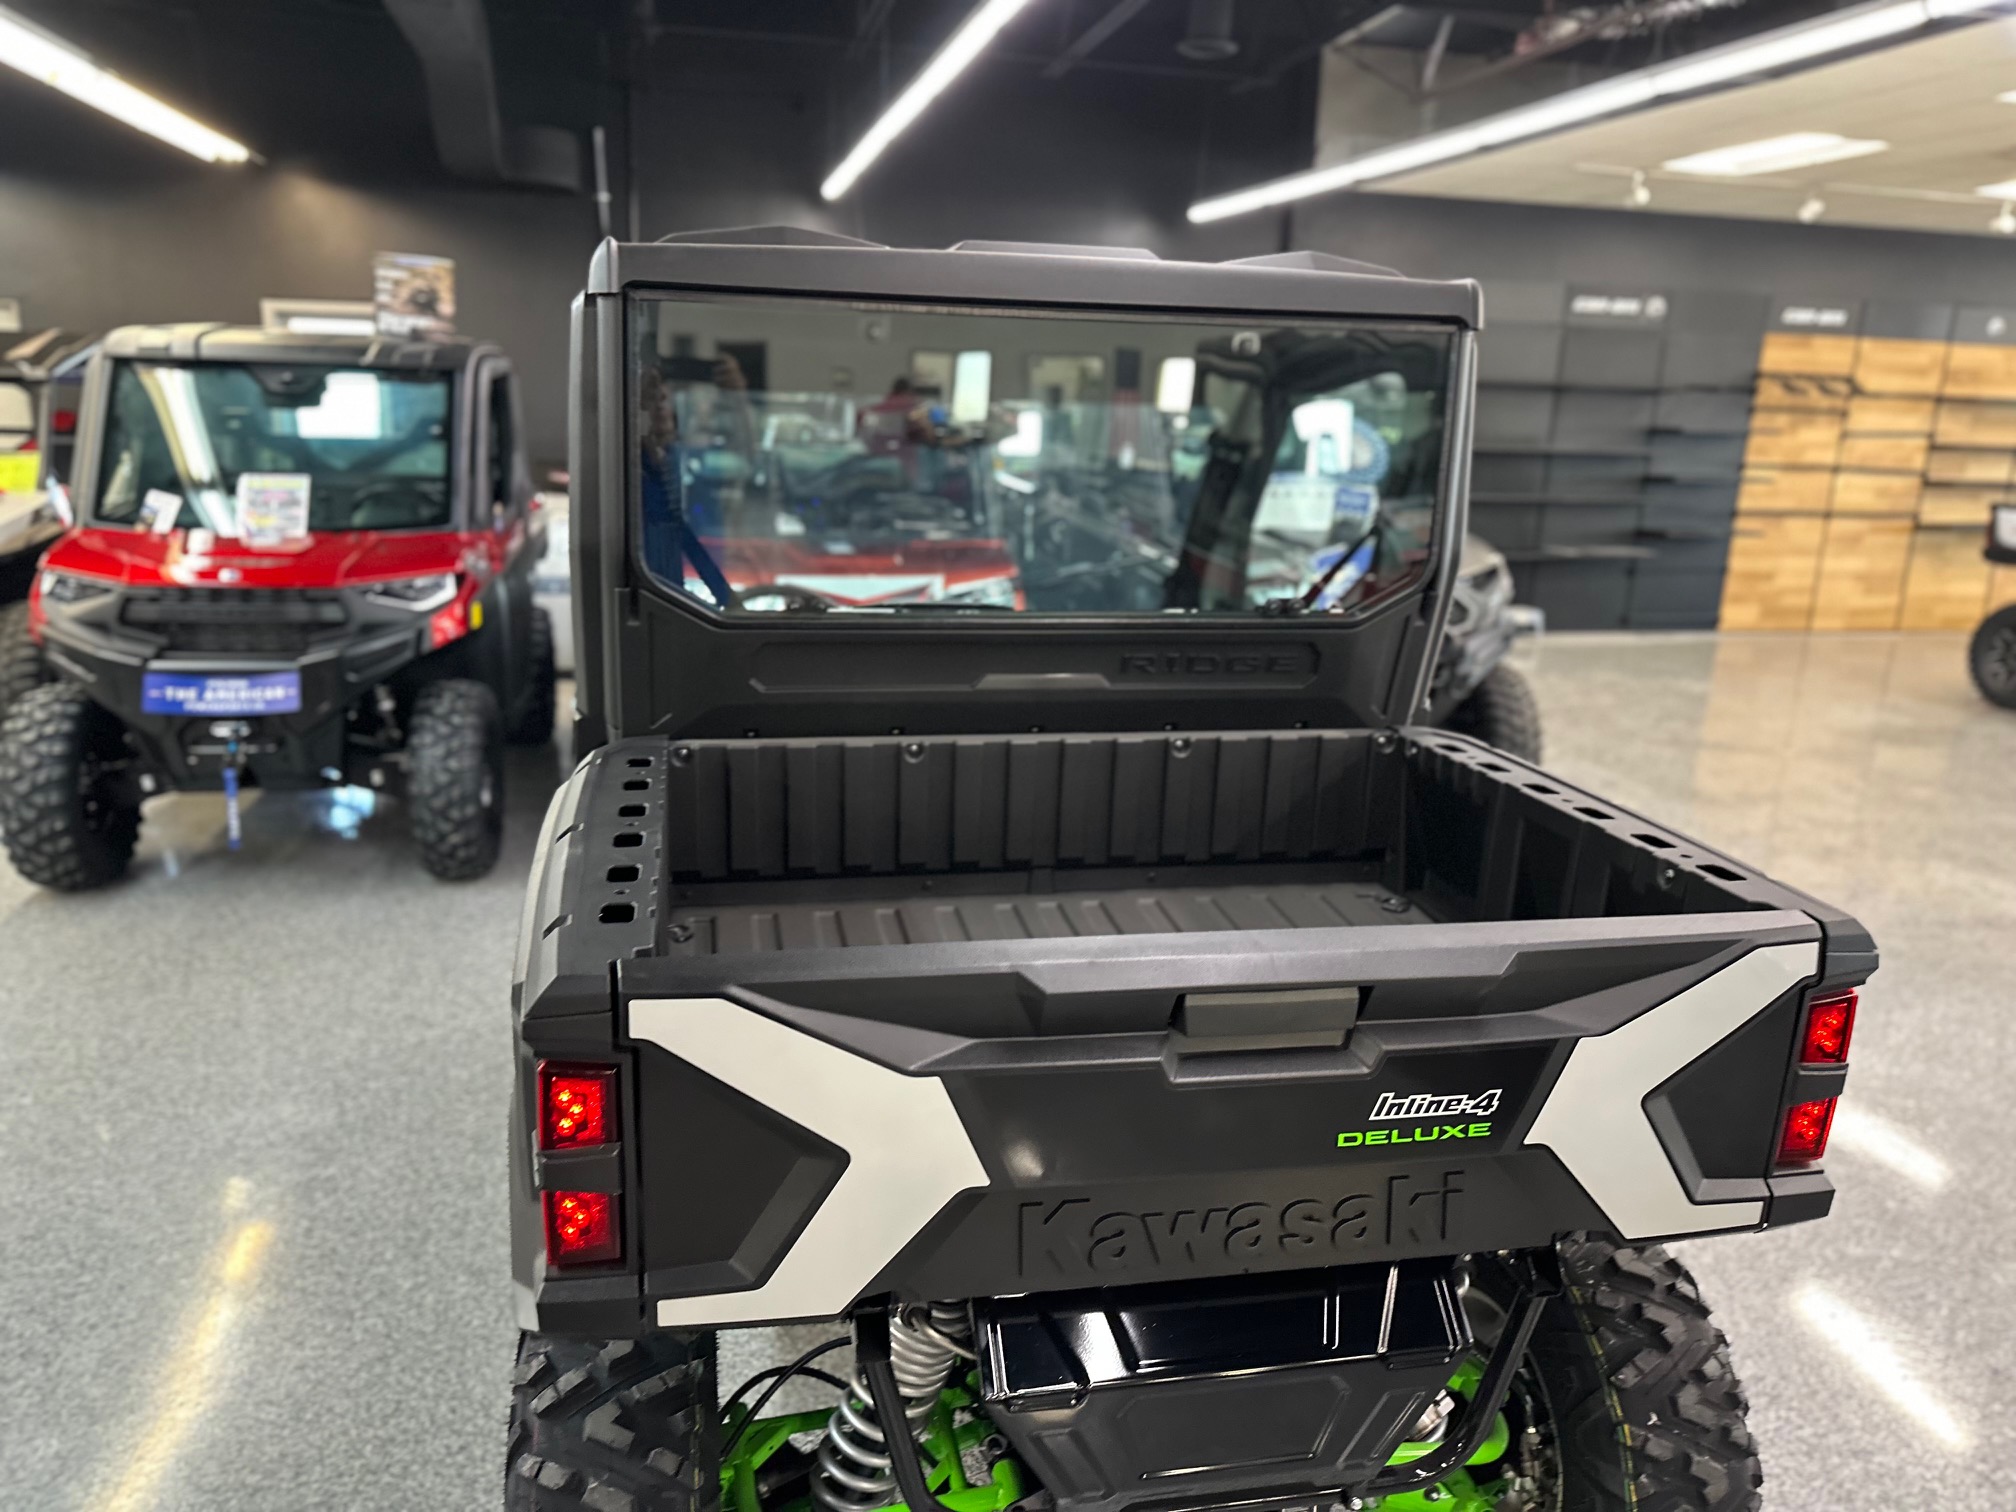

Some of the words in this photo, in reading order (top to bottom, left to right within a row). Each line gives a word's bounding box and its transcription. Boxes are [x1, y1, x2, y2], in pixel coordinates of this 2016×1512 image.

[1119, 653, 1302, 675] RIDGE
[1368, 1088, 1503, 1121] Inline-4
[1336, 1122, 1492, 1147] DELUXE
[1018, 1170, 1465, 1278] Kawasaki
